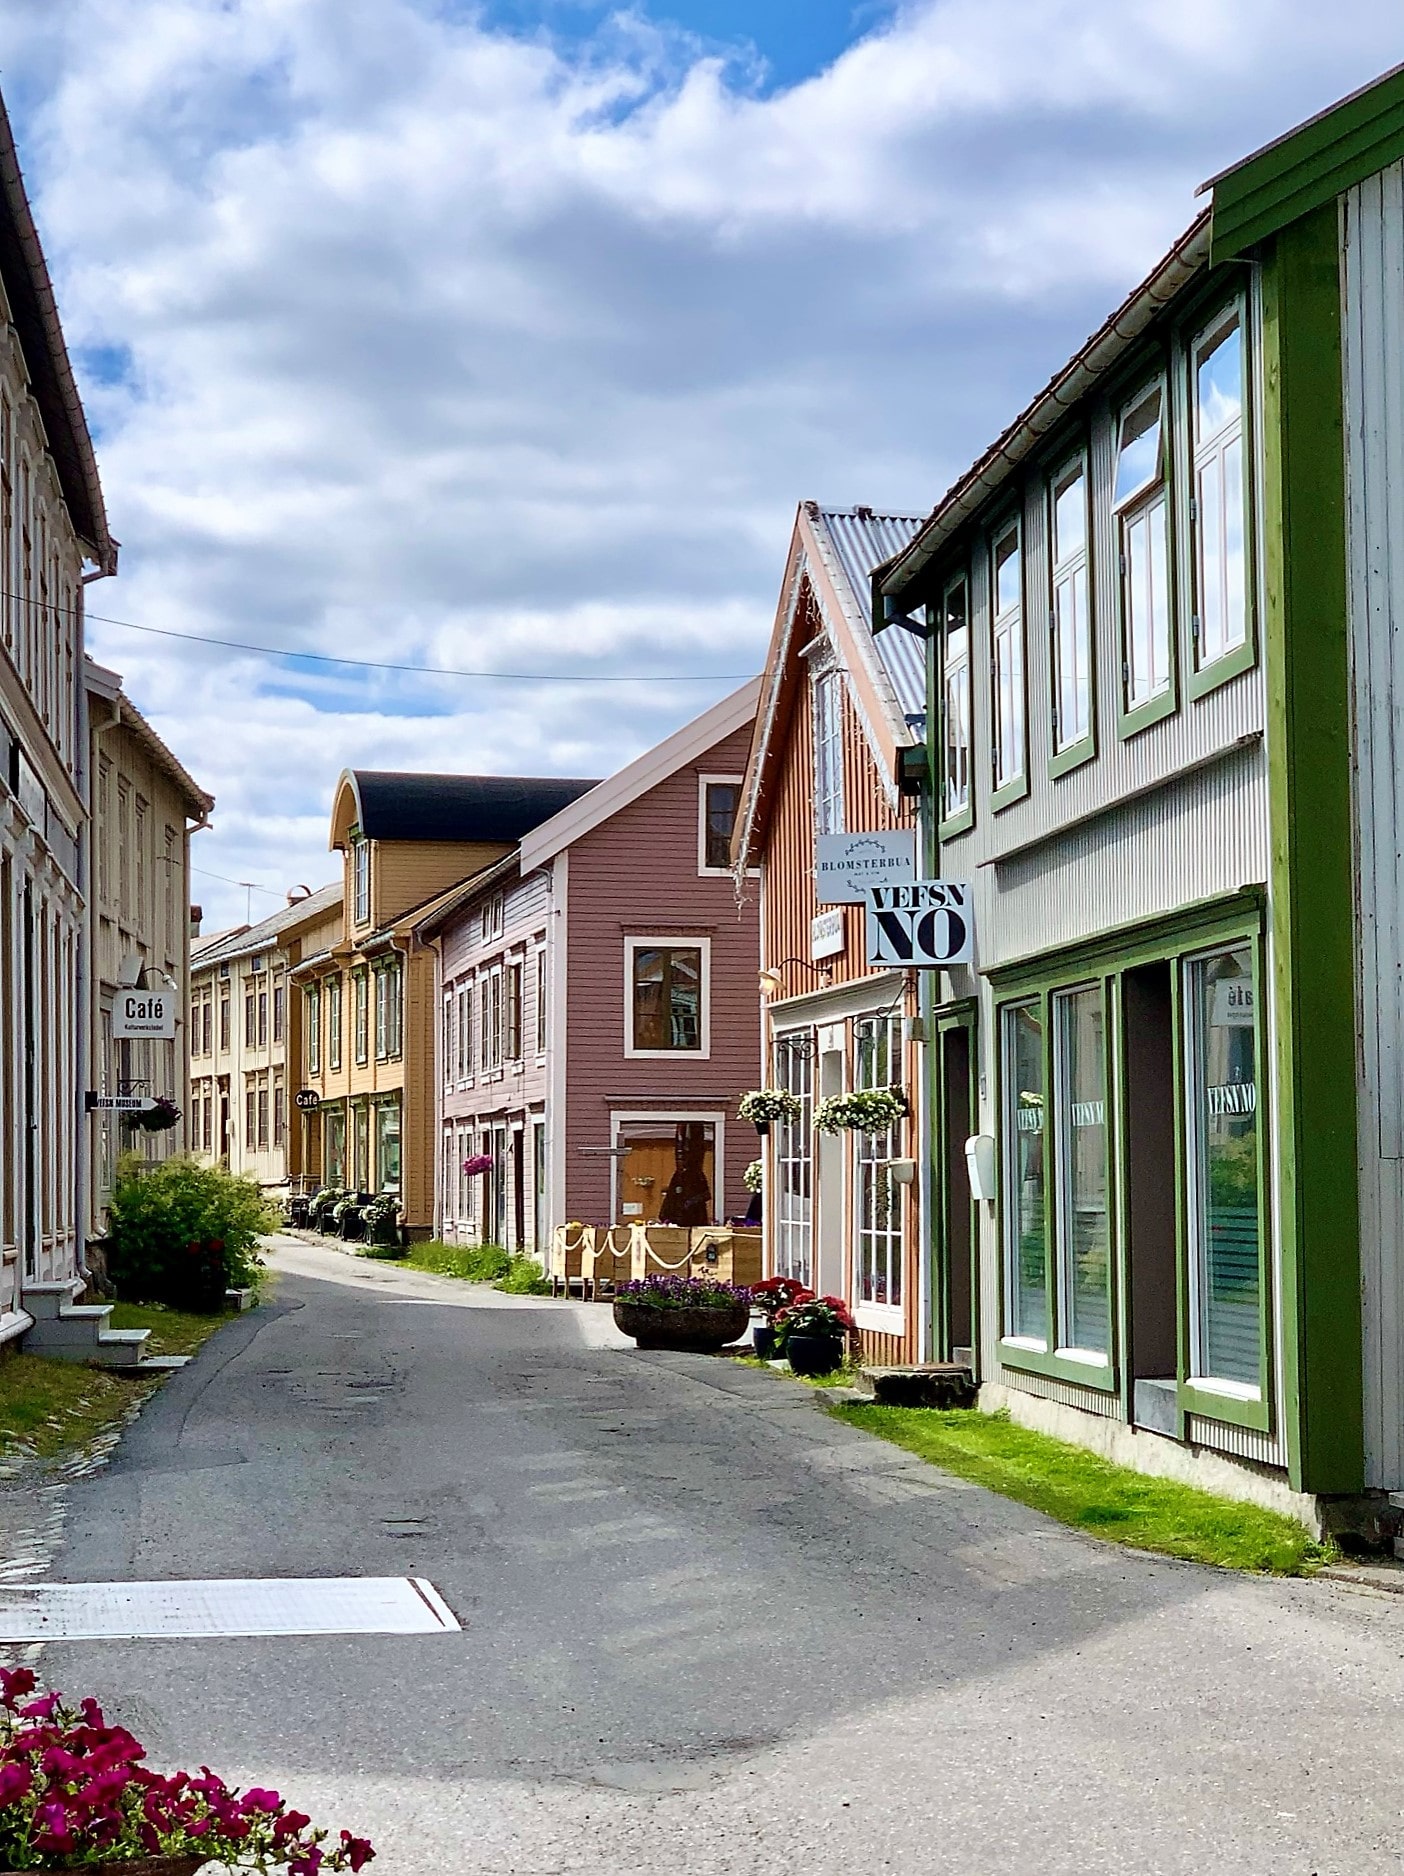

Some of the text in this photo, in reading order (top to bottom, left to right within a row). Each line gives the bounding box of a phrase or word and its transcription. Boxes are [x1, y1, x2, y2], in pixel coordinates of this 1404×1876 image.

[821, 857, 911, 871] BLOMSTERBUA
[870, 883, 967, 909] VEFSN
[869, 907, 967, 961] NO
[125, 997, 163, 1019] Café
[115, 1098, 142, 1108] MUSEUM
[1207, 1082, 1256, 1115] VEFSN NO
